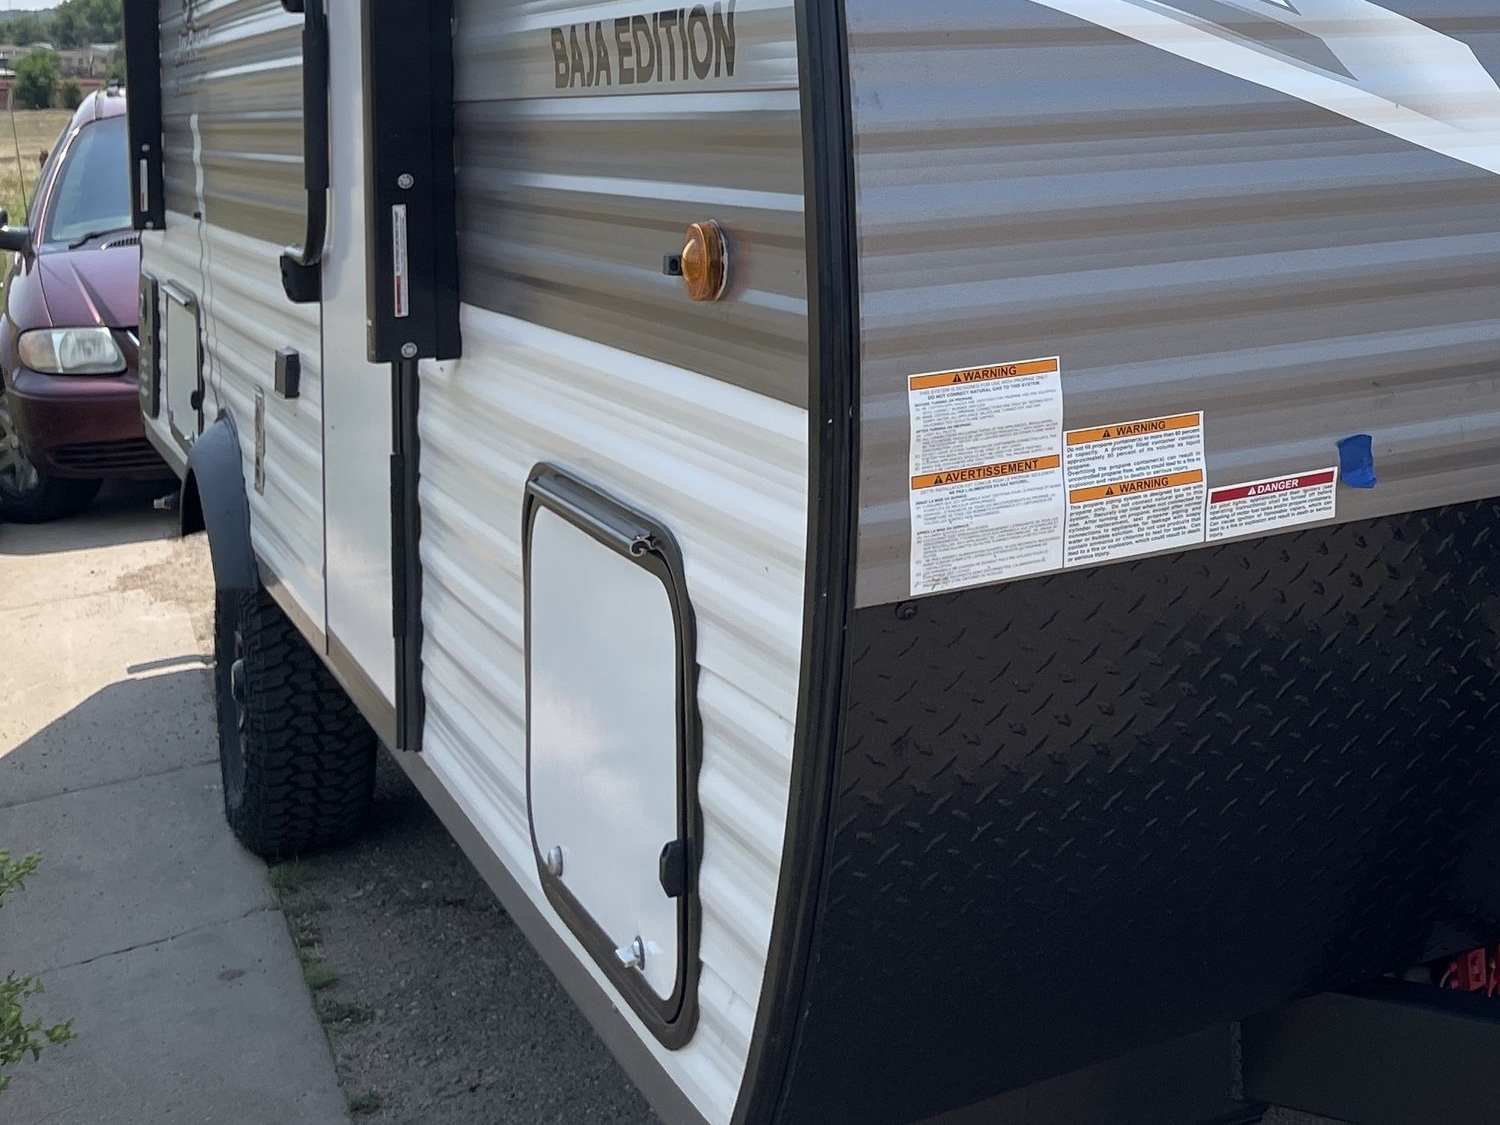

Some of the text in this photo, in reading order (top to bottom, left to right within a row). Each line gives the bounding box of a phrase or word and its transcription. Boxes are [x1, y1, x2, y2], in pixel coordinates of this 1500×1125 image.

[551, 0, 736, 88] BAJA EDITION
[964, 365, 1017, 381] WARNING
[1116, 421, 1166, 435] WARNING
[945, 460, 1039, 483] AVERTISSEMENT
[1120, 477, 1169, 493] WARNING
[1257, 479, 1299, 494] DANGER
